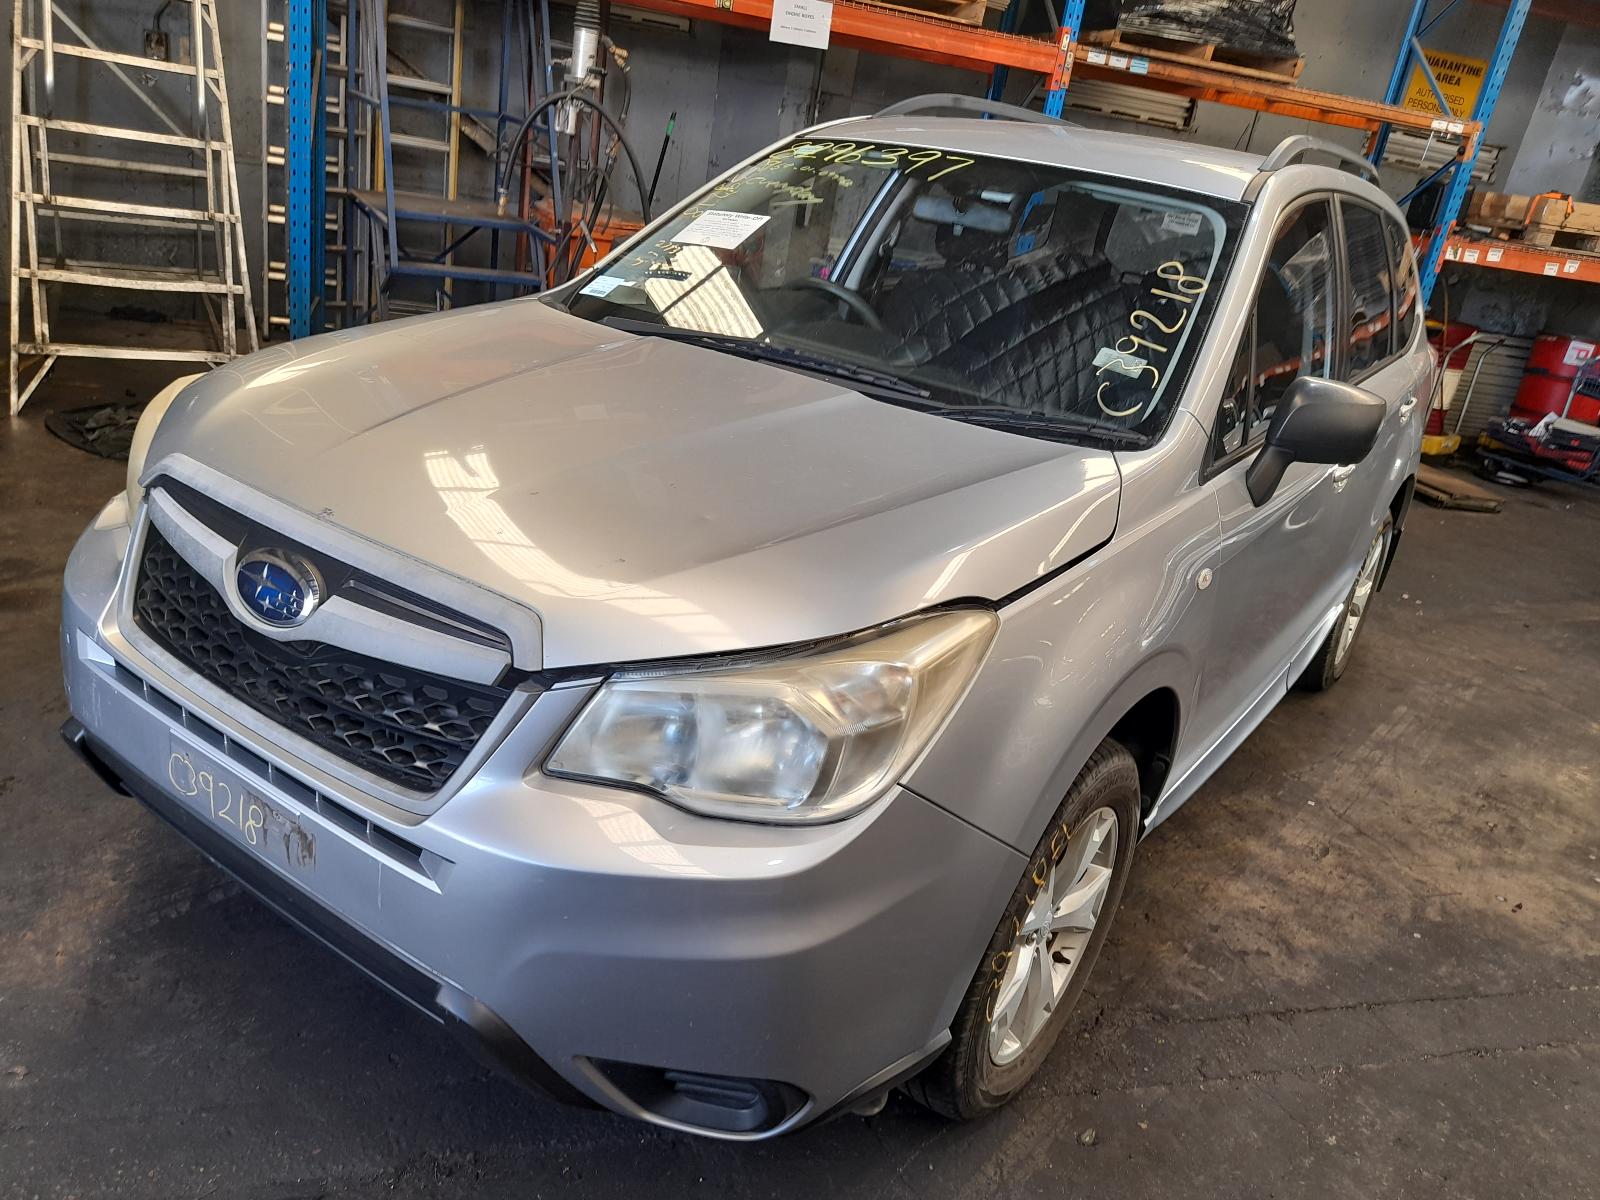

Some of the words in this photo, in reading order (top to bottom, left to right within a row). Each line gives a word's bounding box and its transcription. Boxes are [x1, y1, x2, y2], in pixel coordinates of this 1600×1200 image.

[1435, 71, 1462, 87] AREA
[1096, 261, 1209, 418] C39218
[168, 752, 264, 845] C39218
